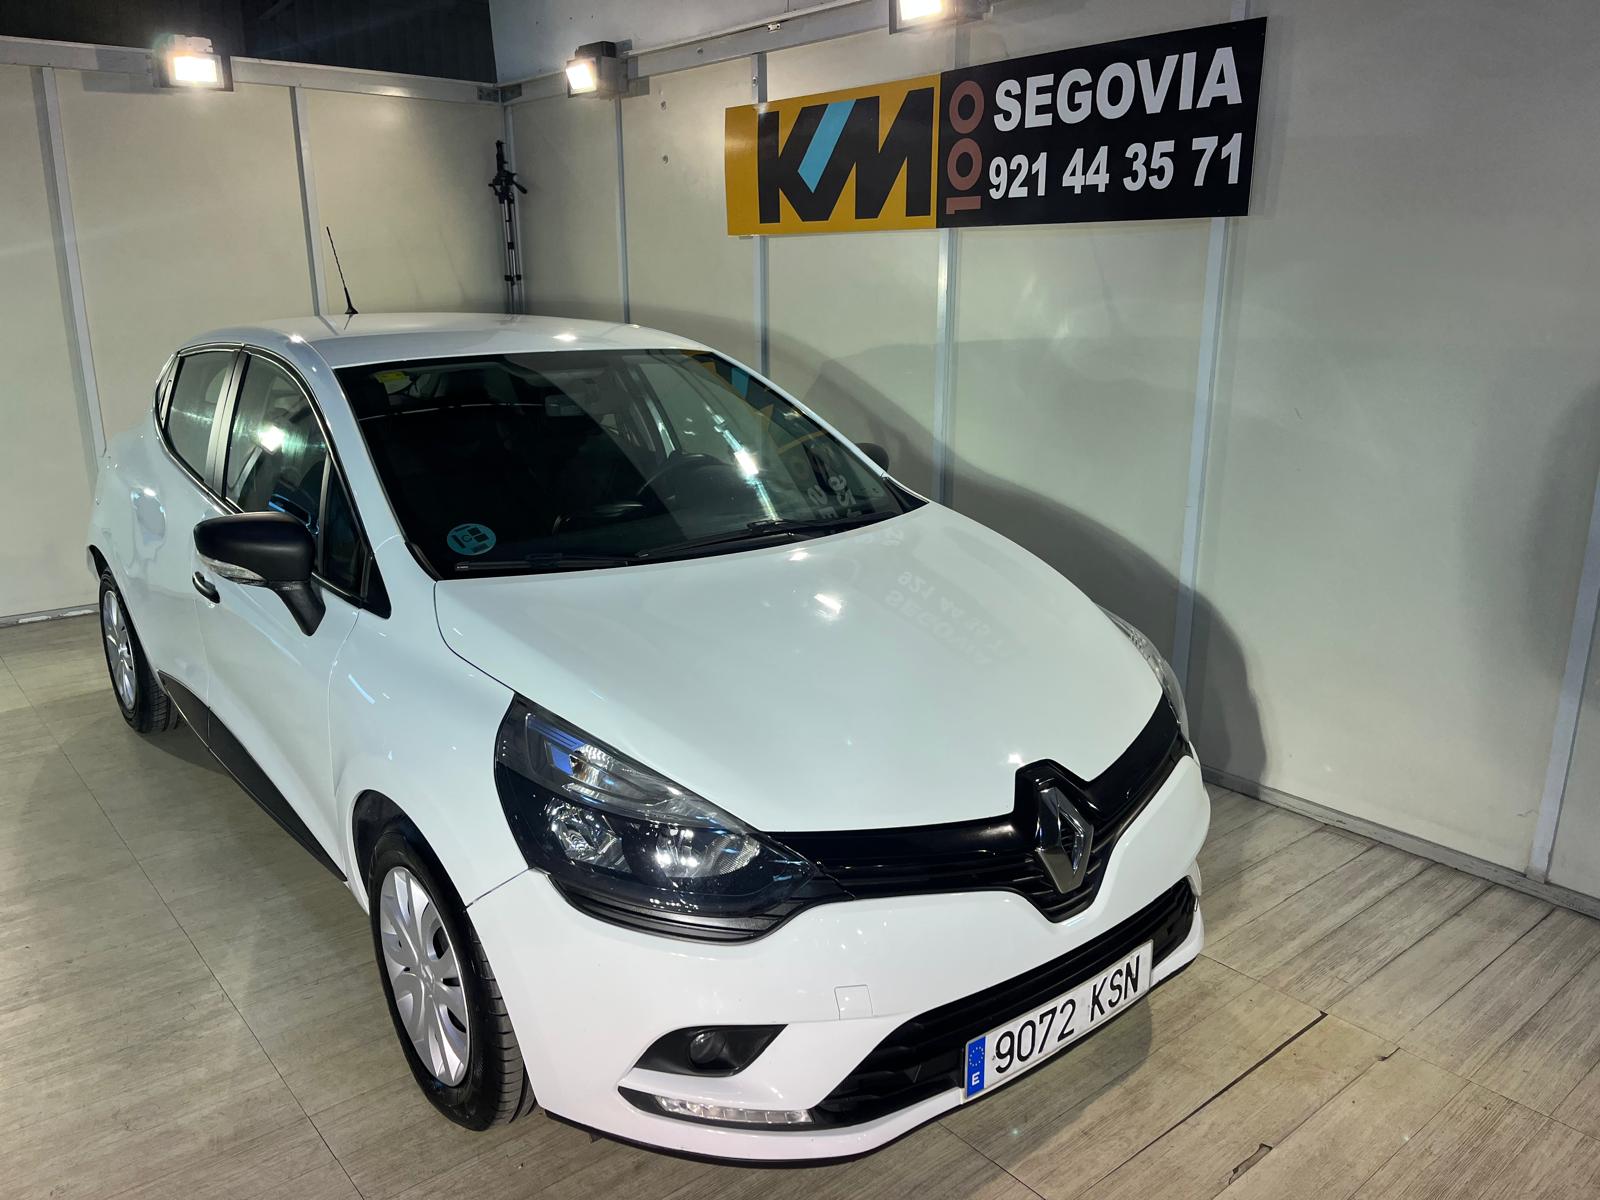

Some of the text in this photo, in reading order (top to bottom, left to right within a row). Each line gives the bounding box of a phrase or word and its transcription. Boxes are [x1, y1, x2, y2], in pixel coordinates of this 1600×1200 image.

[993, 46, 1242, 132] SEGOVIA
[757, 87, 935, 224] KM
[945, 80, 985, 215] 100
[989, 132, 1242, 200] 921 44 35 71
[995, 955, 1140, 1074] 9072 KSN
[971, 1072, 980, 1086] E
